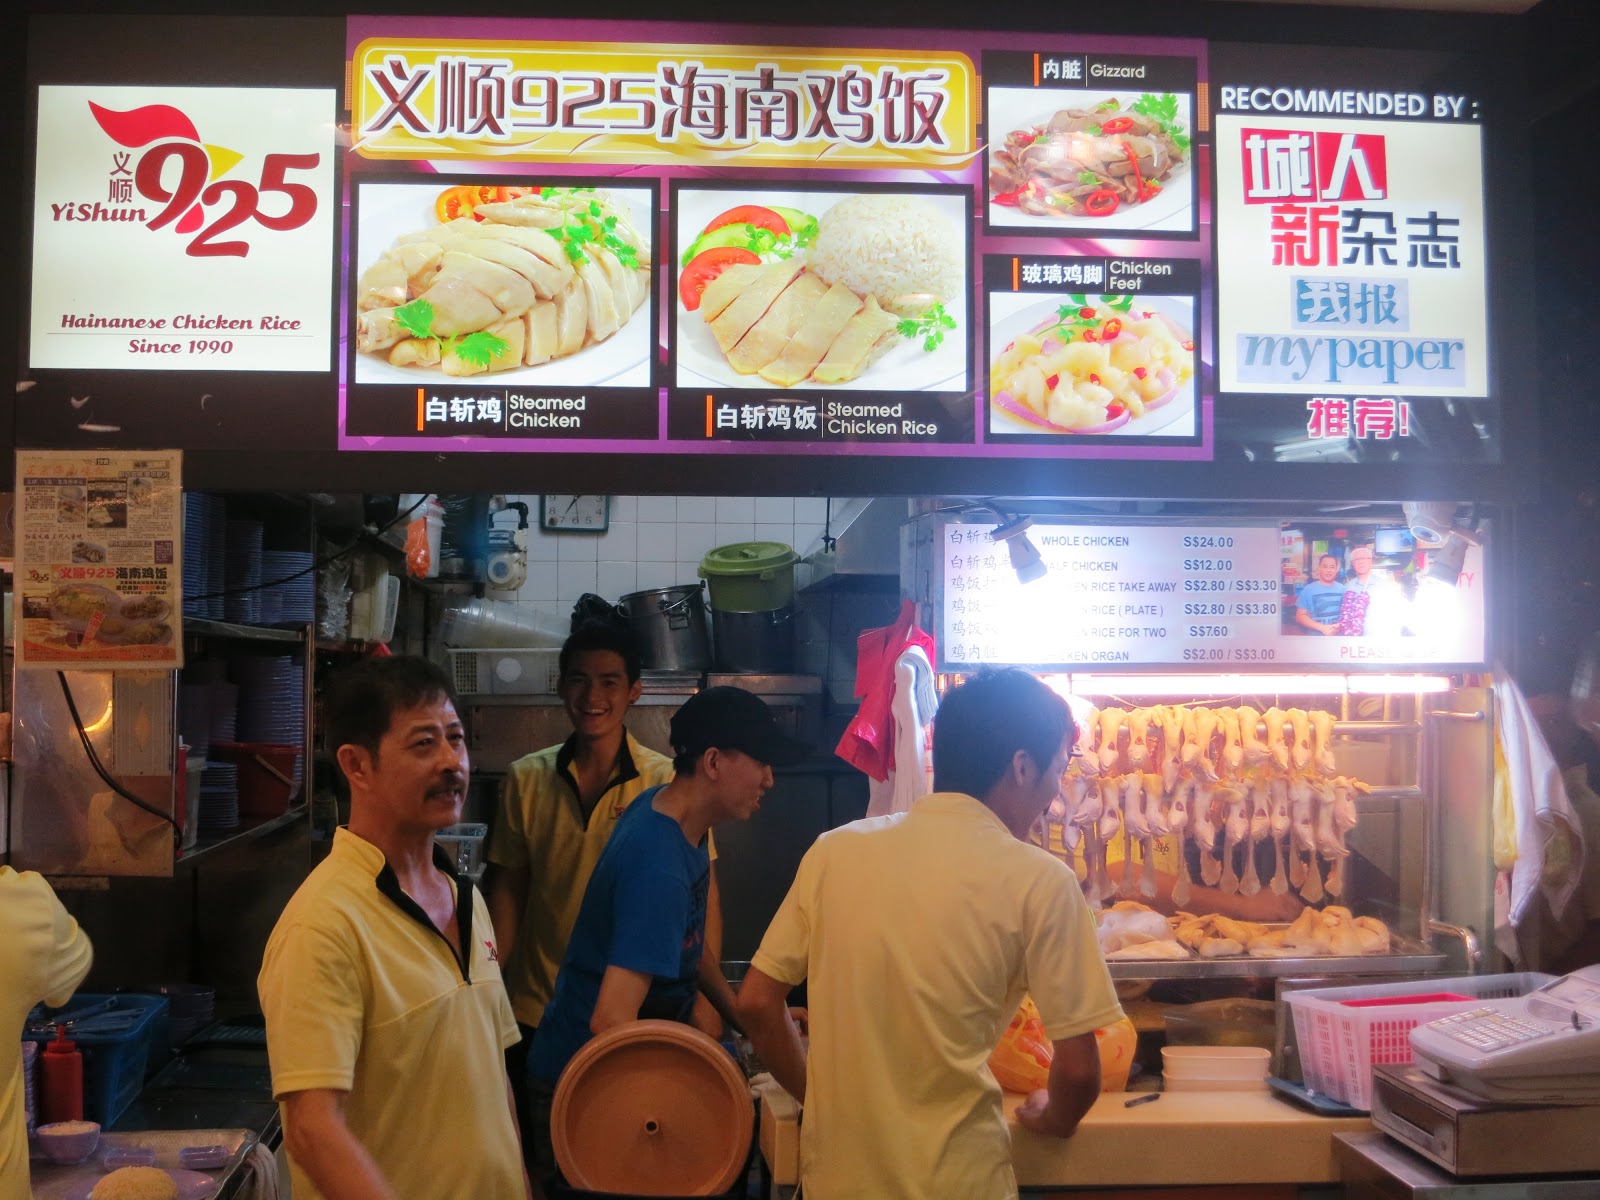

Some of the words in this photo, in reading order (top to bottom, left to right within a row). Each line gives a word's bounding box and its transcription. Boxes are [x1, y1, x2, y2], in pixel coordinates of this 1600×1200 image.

[1043, 59, 1081, 80] 内脏
[1090, 64, 1145, 79] Gizzard
[365, 59, 946, 145] 义顺925海南鸡饭
[1221, 87, 1424, 116] RECOMMENDED
[1433, 96, 1464, 118] BY
[109, 151, 133, 203] 义顺
[135, 142, 320, 257] 925
[51, 202, 148, 222] YiShun
[1270, 203, 1461, 269] 新杂志
[1022, 264, 1102, 285] 玻璃鸡脚
[1109, 261, 1172, 276] Chicken
[1109, 277, 1142, 290] Feet
[1296, 279, 1399, 325] 我报
[61, 314, 167, 329] Hainanese
[172, 315, 254, 330] Chicken
[260, 316, 302, 330] Rice
[128, 339, 182, 354] Since
[188, 340, 233, 354] 1990
[425, 396, 502, 423] 白斩鸡
[510, 395, 586, 412] Steamed
[827, 402, 902, 418] Steamed
[510, 412, 581, 428] Chicken
[716, 403, 818, 430] 白斩鸡饭
[1307, 397, 1410, 439] 推荐!
[827, 418, 897, 435] Chicken
[902, 420, 938, 436] Rice
[1041, 536, 1080, 546] WHOLE
[1082, 536, 1129, 547] CHICKEN
[1183, 536, 1233, 548] S$24.00
[1071, 561, 1118, 572] CHICKEN
[1183, 559, 1232, 571] S$12.00
[1091, 582, 1117, 592] RICE
[1118, 582, 1147, 592] TAKE
[1148, 582, 1177, 593] AWAY
[1184, 580, 1225, 592] S$2.80
[1235, 580, 1277, 592] S$3.30
[1091, 604, 1117, 615] RICE
[1124, 605, 1158, 615] PLATE
[1184, 603, 1225, 615] S$2.80
[1235, 603, 1277, 615] S$3.80
[1091, 627, 1117, 638] RICE
[1118, 627, 1141, 638] FOR
[1142, 627, 1167, 638] TWO
[1189, 625, 1228, 637] S$7.60
[1091, 650, 1129, 661] ORGAN
[1183, 649, 1224, 660] S$2.00
[1234, 649, 1275, 660] S$3.00
